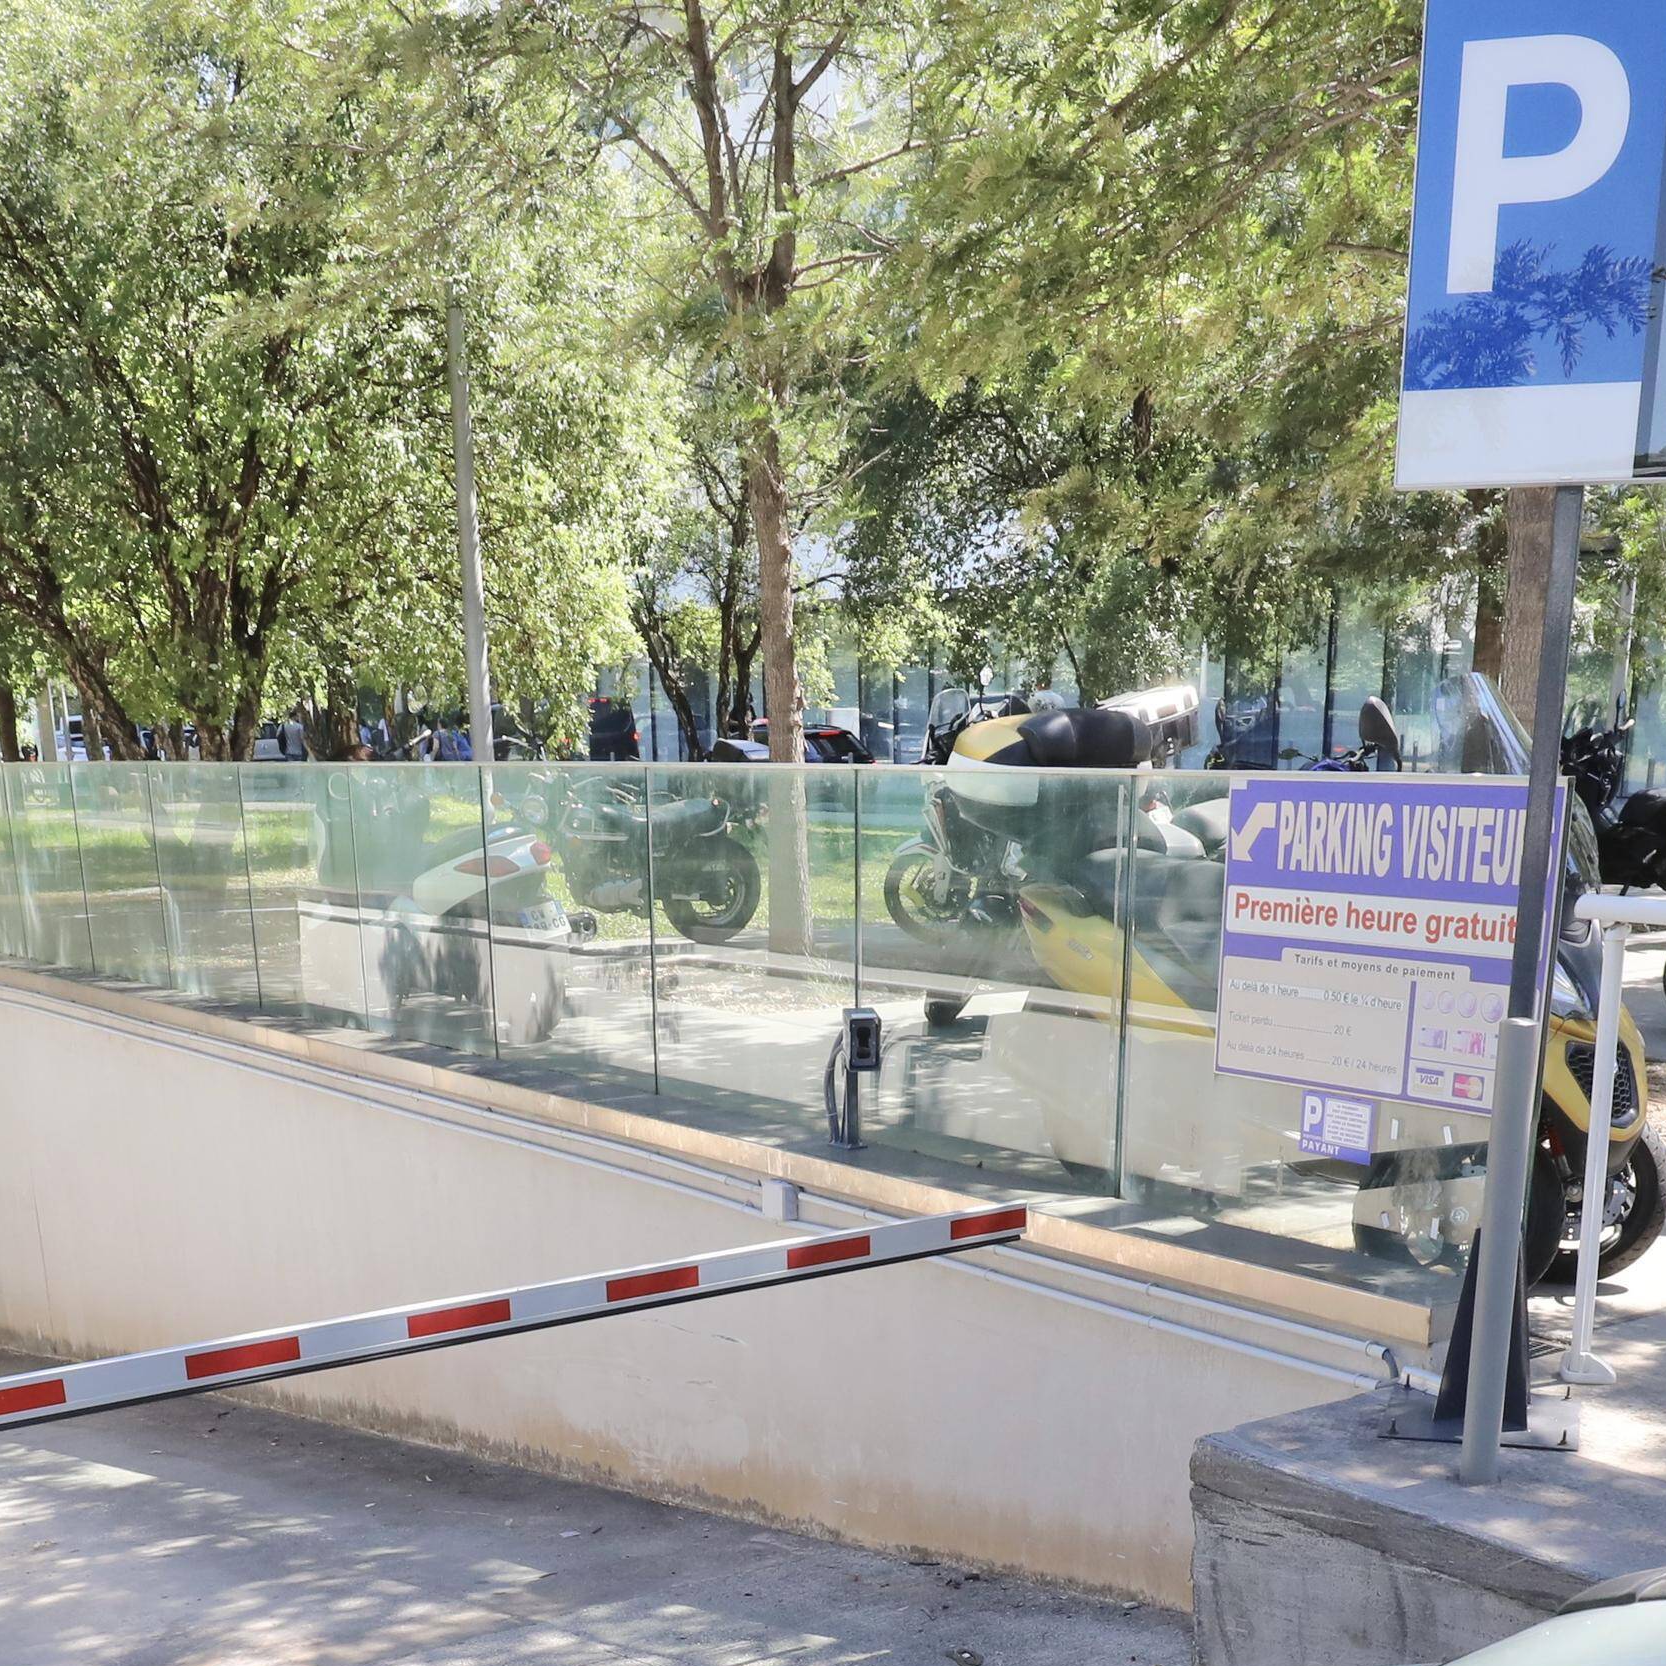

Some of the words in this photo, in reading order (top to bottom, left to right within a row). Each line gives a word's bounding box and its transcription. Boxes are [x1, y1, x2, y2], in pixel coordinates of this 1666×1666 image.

[1446, 34, 1631, 294] P
[1276, 800, 1394, 878] PARKING
[1402, 804, 1555, 887] VISITEU
[1235, 892, 1339, 928] Première
[1346, 901, 1418, 934] heure
[1425, 911, 1519, 944] gratuit
[1294, 953, 1324, 967] Tarifs
[1327, 957, 1338, 968] et
[1341, 961, 1381, 975] moyens
[1386, 964, 1399, 975] de
[1402, 967, 1455, 982] paiement
[1229, 979, 1241, 990] Au
[1242, 981, 1258, 993] delà
[1260, 982, 1270, 993] de
[1277, 985, 1299, 998] heure
[1343, 993, 1350, 1004] €
[1334, 1025, 1345, 1036] 20
[1346, 1026, 1352, 1037] €
[1226, 1040, 1237, 1051] Au
[1267, 1044, 1277, 1055] 24
[1332, 1055, 1343, 1067] 20
[1344, 1057, 1350, 1067] €
[1356, 1058, 1368, 1070] 24
[1369, 1060, 1397, 1074] heures
[1420, 1074, 1439, 1086] VISA
[1303, 1095, 1323, 1132] P
[1302, 1139, 1340, 1156] PAYANT
